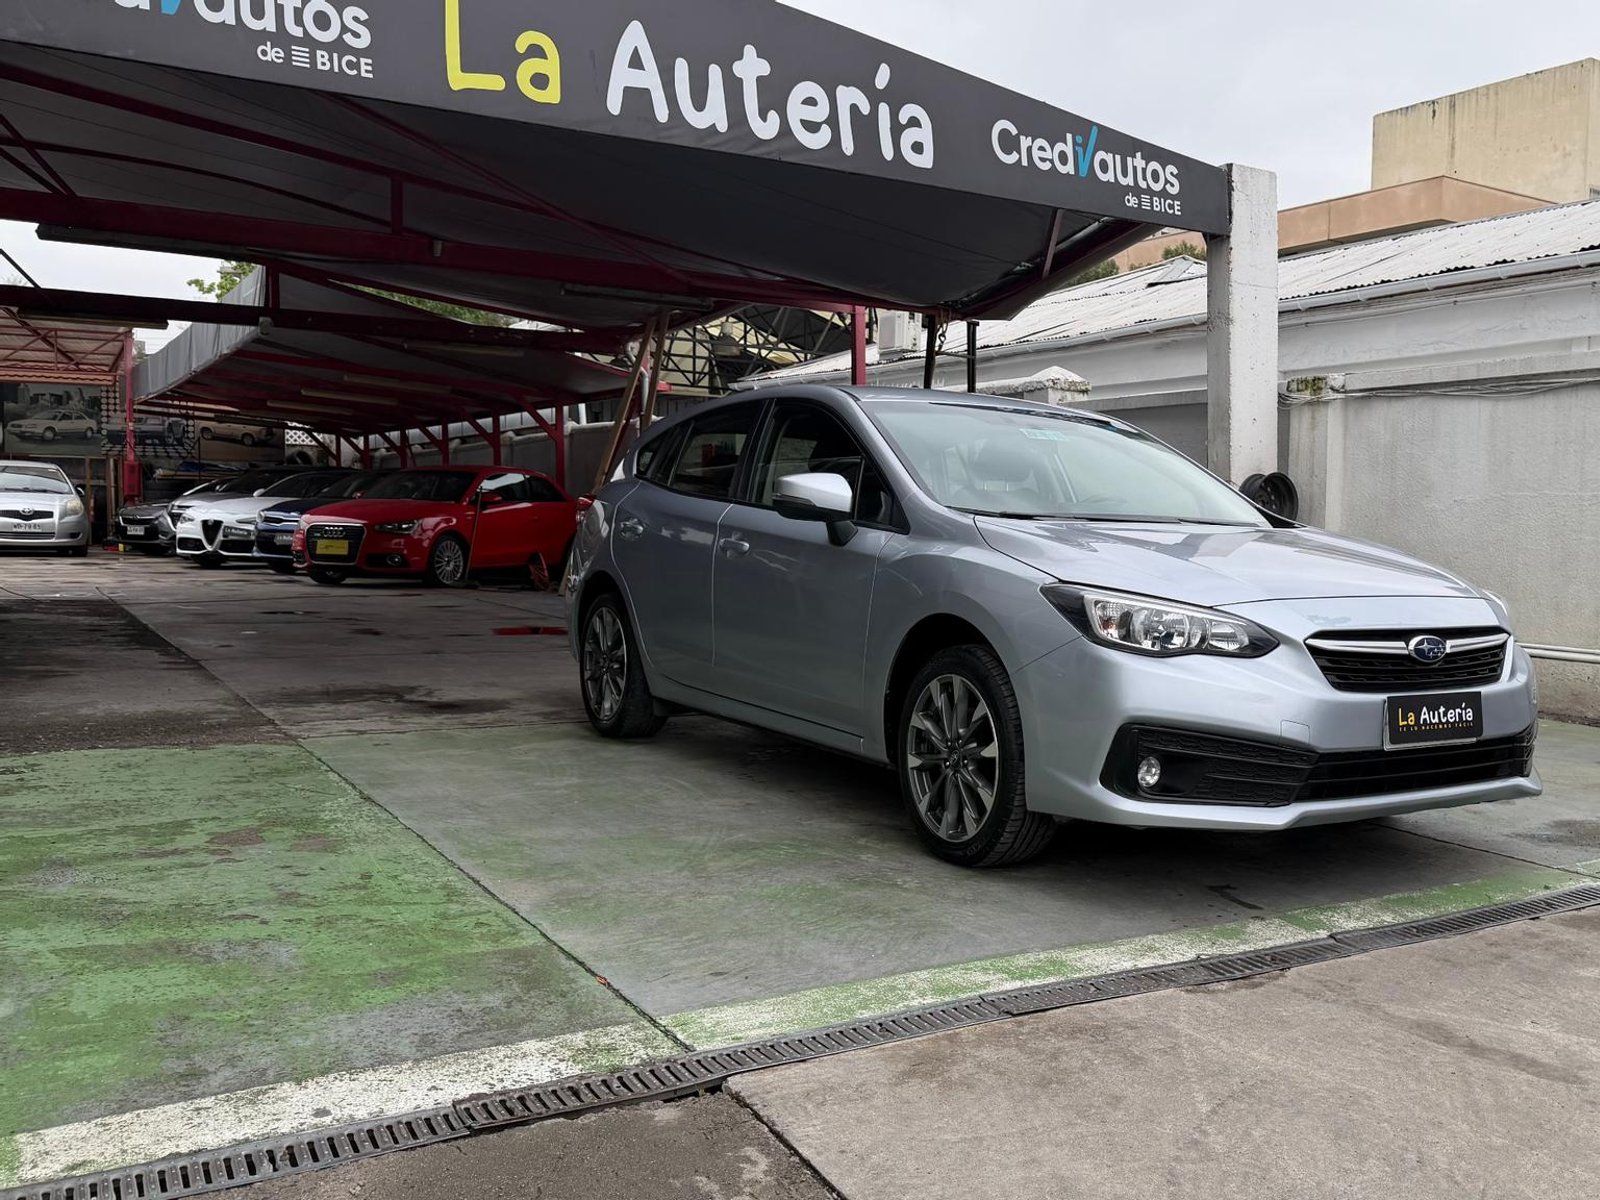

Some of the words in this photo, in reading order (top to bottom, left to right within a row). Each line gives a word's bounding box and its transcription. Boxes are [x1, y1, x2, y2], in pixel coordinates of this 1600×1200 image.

[256, 41, 285, 64] de
[316, 49, 374, 79] BICE
[444, 0, 562, 104] La
[605, 19, 935, 169] Autería
[1124, 192, 1139, 208] de
[1152, 196, 1182, 215] BICE
[1398, 707, 1416, 726] La
[1420, 702, 1474, 724] Autería
